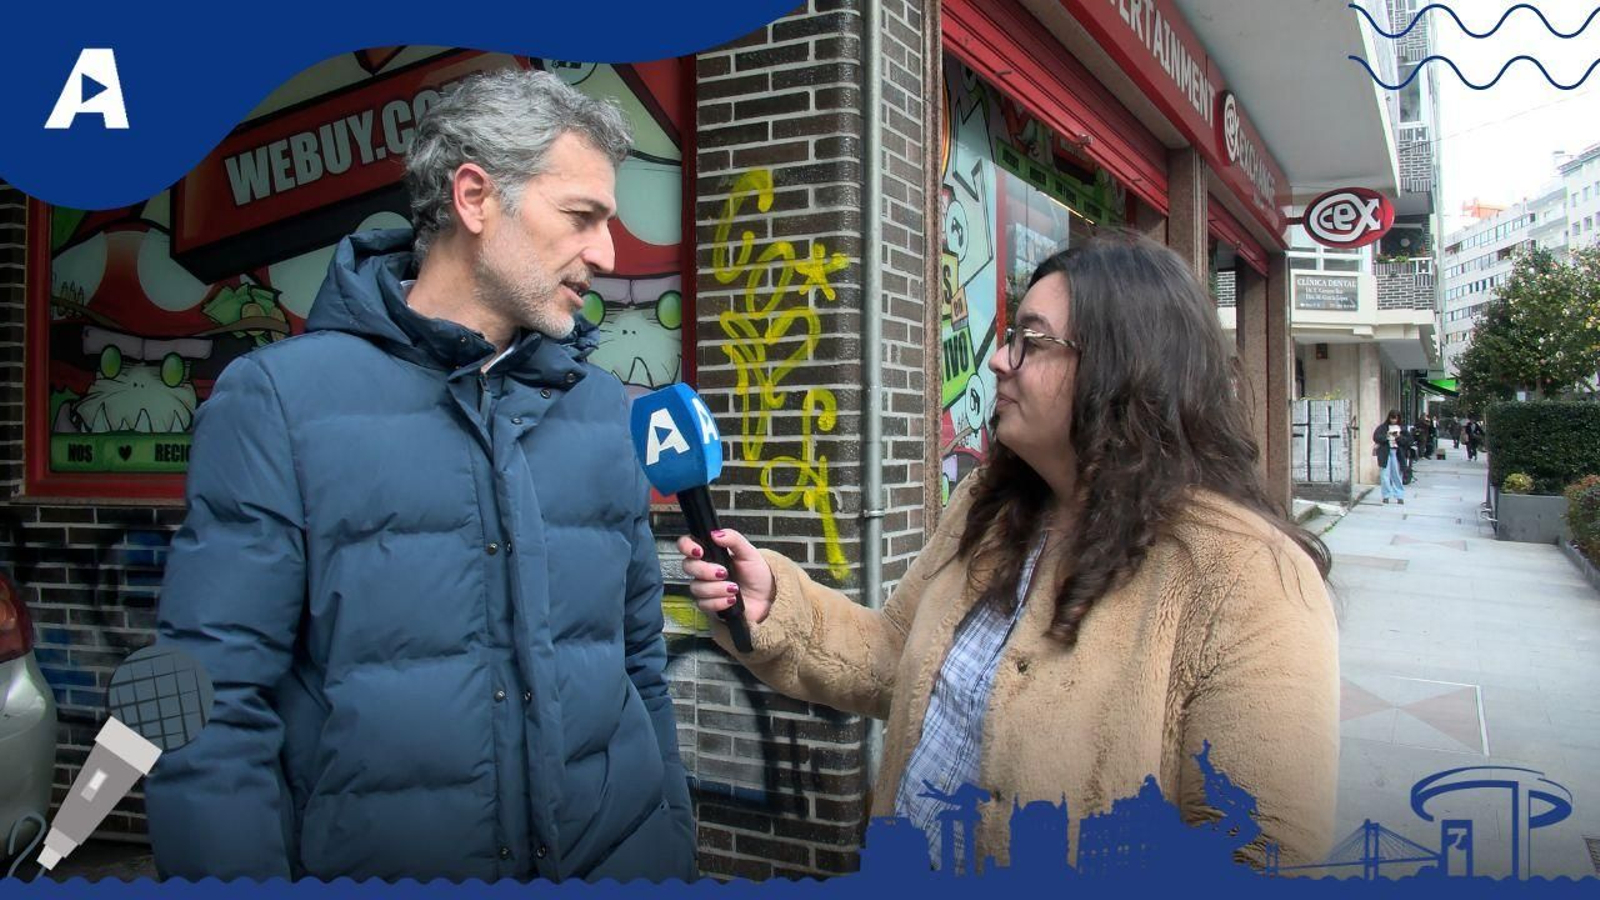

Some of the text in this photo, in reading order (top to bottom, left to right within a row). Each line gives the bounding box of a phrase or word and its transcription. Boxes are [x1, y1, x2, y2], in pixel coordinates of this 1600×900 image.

[1110, 0, 1215, 129] RTAINMENT
[225, 82, 458, 206] WEBUY.CO
[1328, 279, 1357, 288] DENTAL
[68, 443, 93, 462] NOS
[646, 408, 690, 465] A
